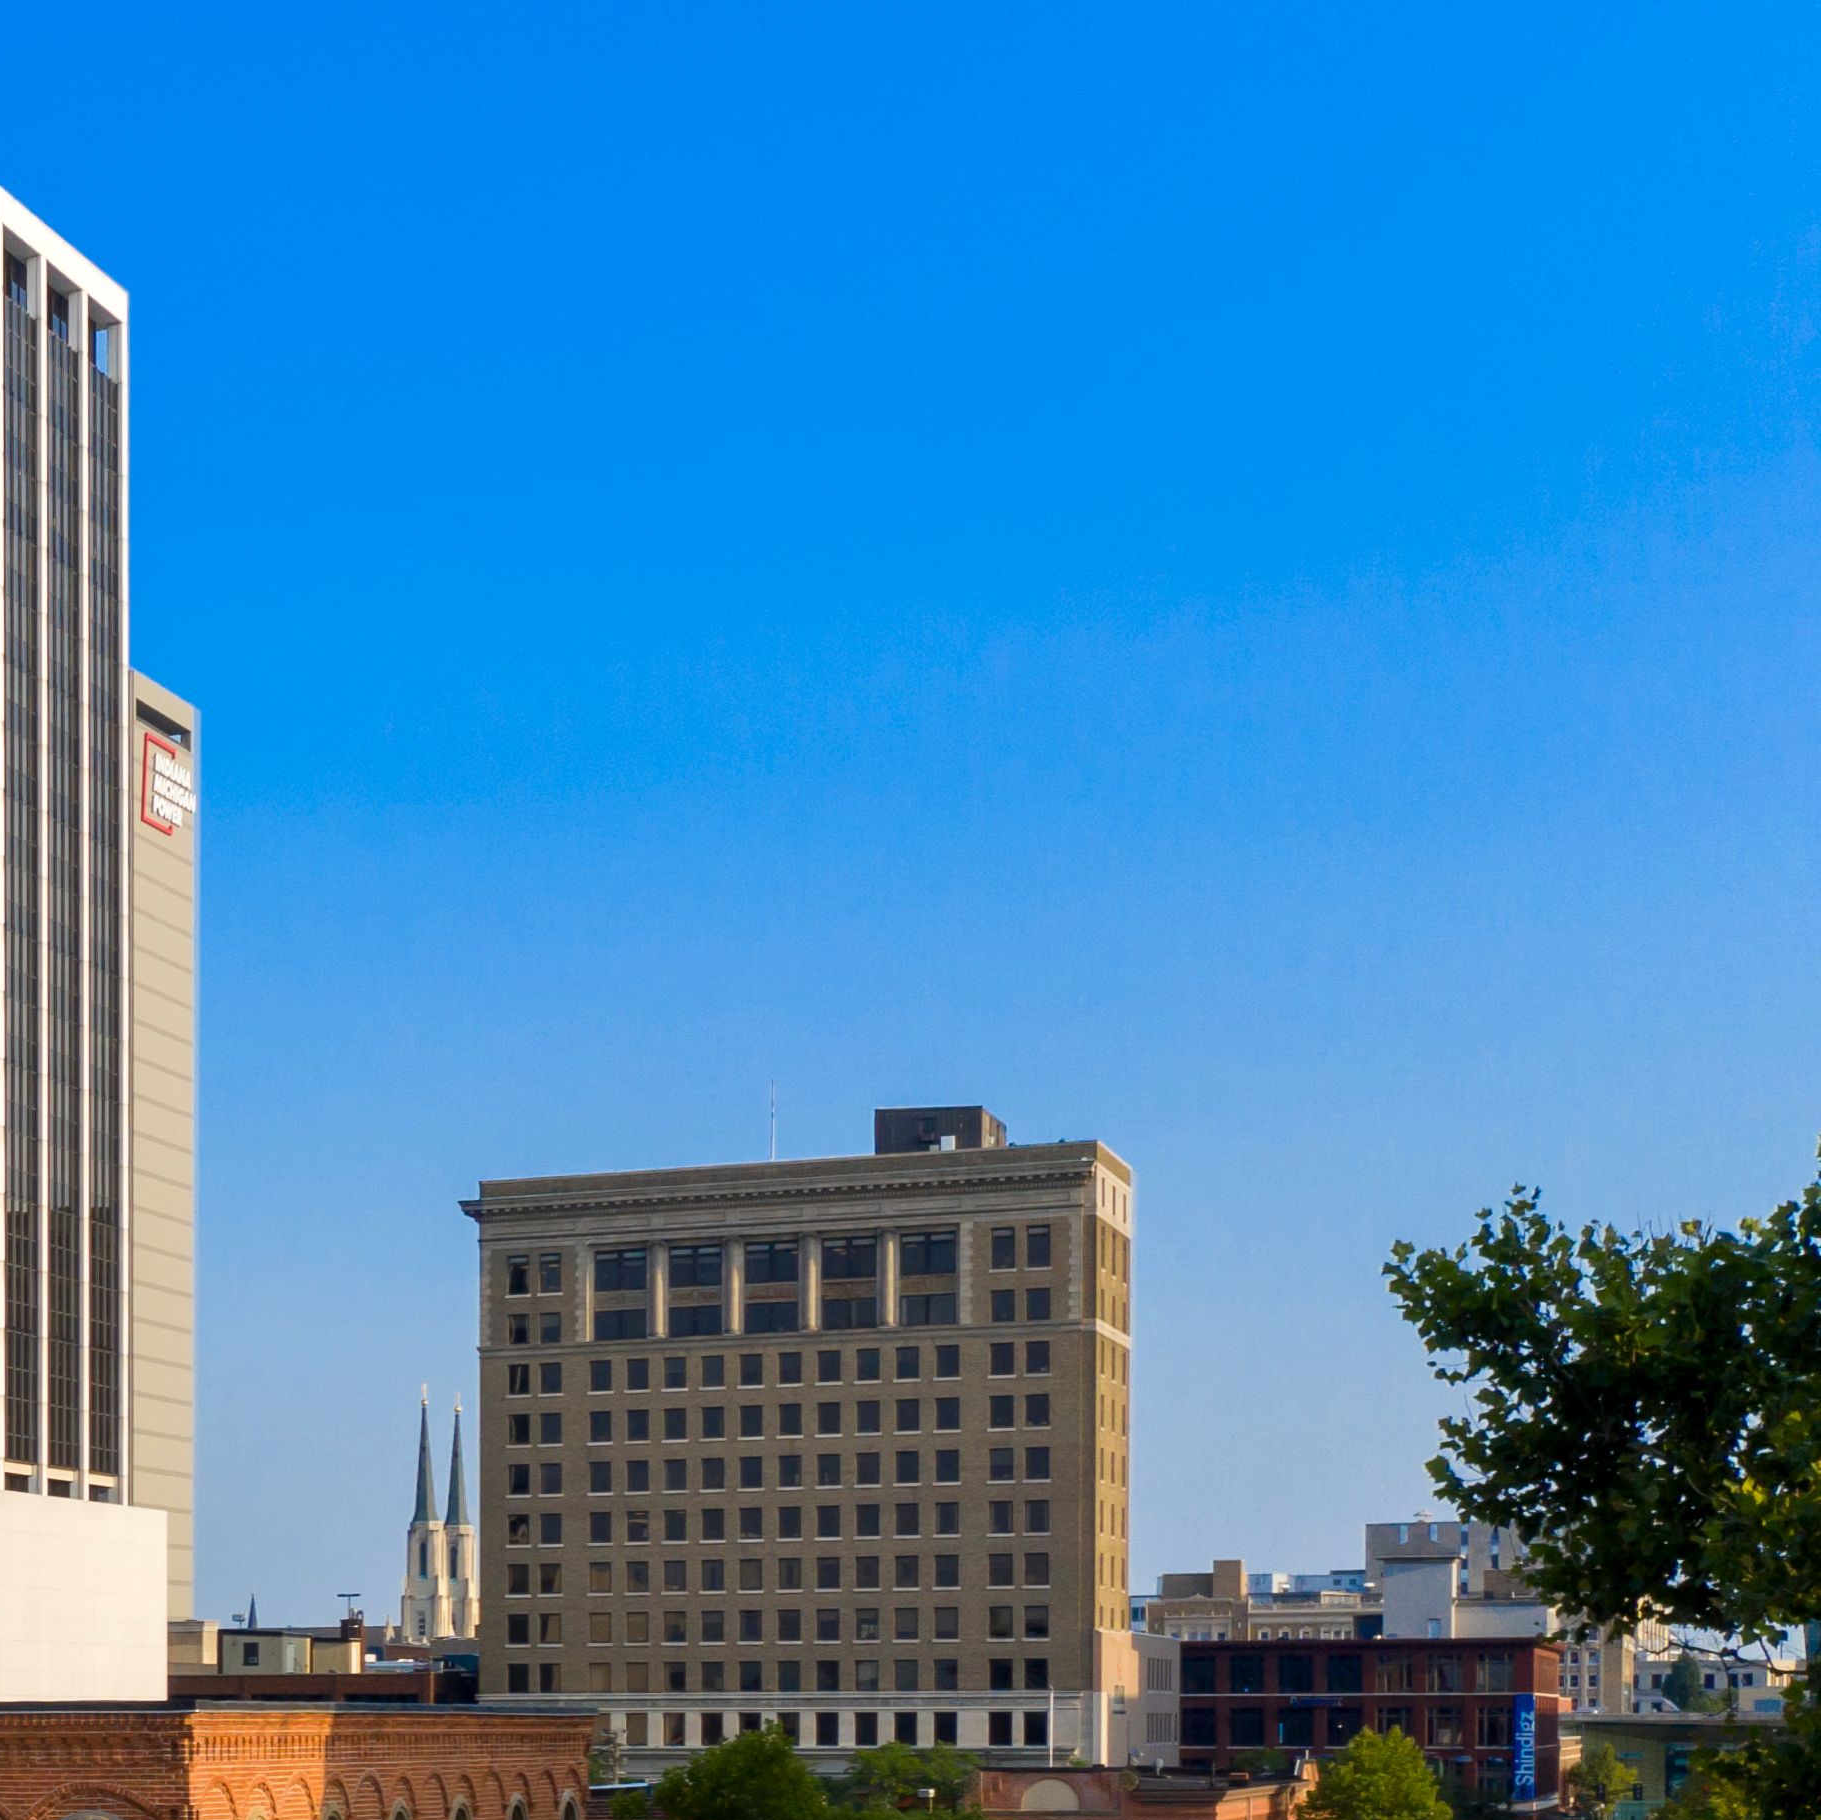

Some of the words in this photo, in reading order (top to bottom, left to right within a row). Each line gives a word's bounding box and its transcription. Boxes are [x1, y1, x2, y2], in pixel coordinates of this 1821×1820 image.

[154, 752, 191, 790] INDIANA
[152, 794, 183, 827] POWER
[153, 773, 197, 814] MICHIGAN
[1514, 1711, 1535, 1786] Shindigz
